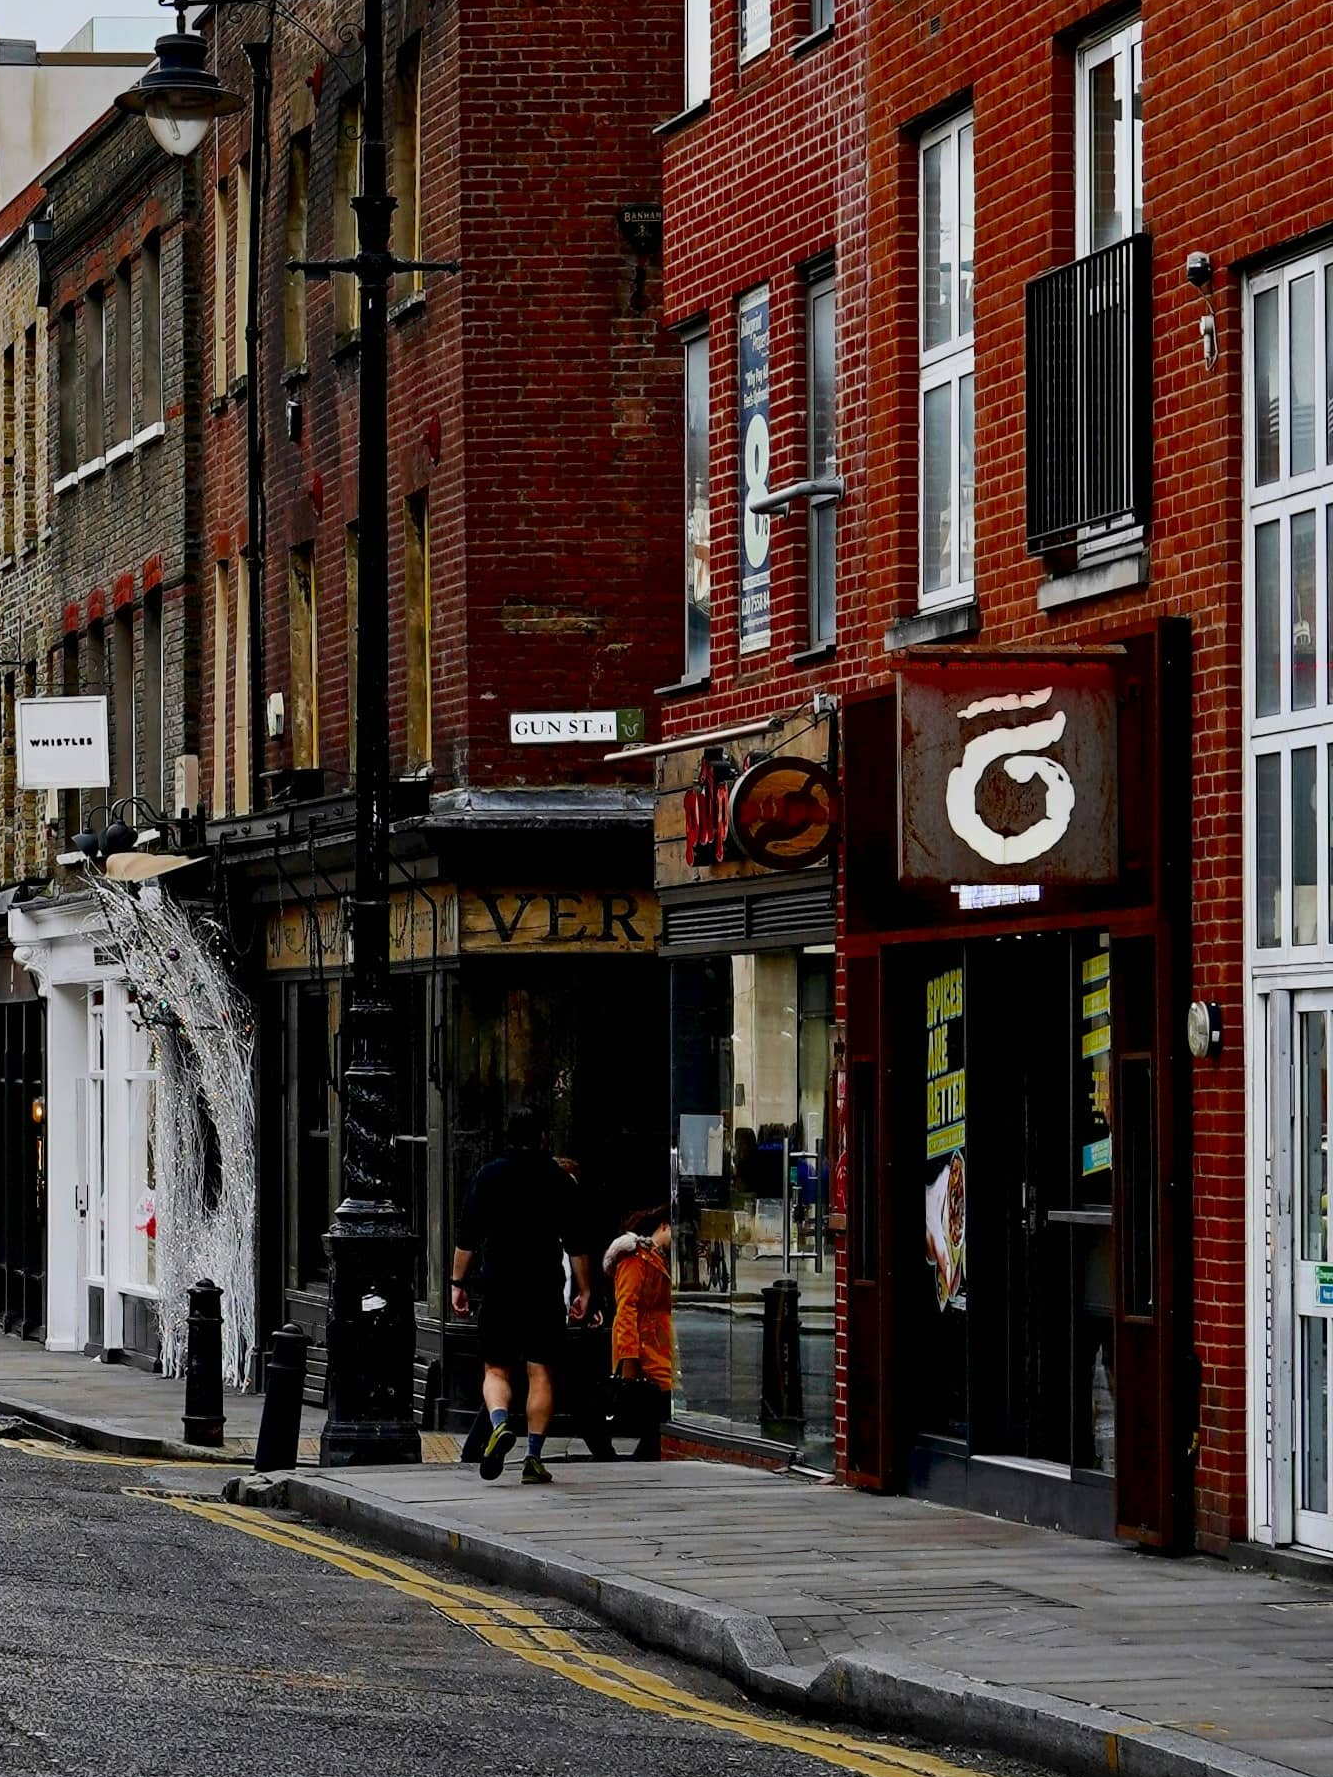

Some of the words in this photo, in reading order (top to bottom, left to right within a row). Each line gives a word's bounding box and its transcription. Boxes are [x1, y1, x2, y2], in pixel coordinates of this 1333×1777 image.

[29, 737, 93, 747] WHISTLES
[515, 720, 561, 736] GUN
[569, 719, 597, 734] ST.
[479, 893, 645, 942] VER
[926, 967, 963, 1029] SPICES
[927, 1023, 948, 1080] ARE
